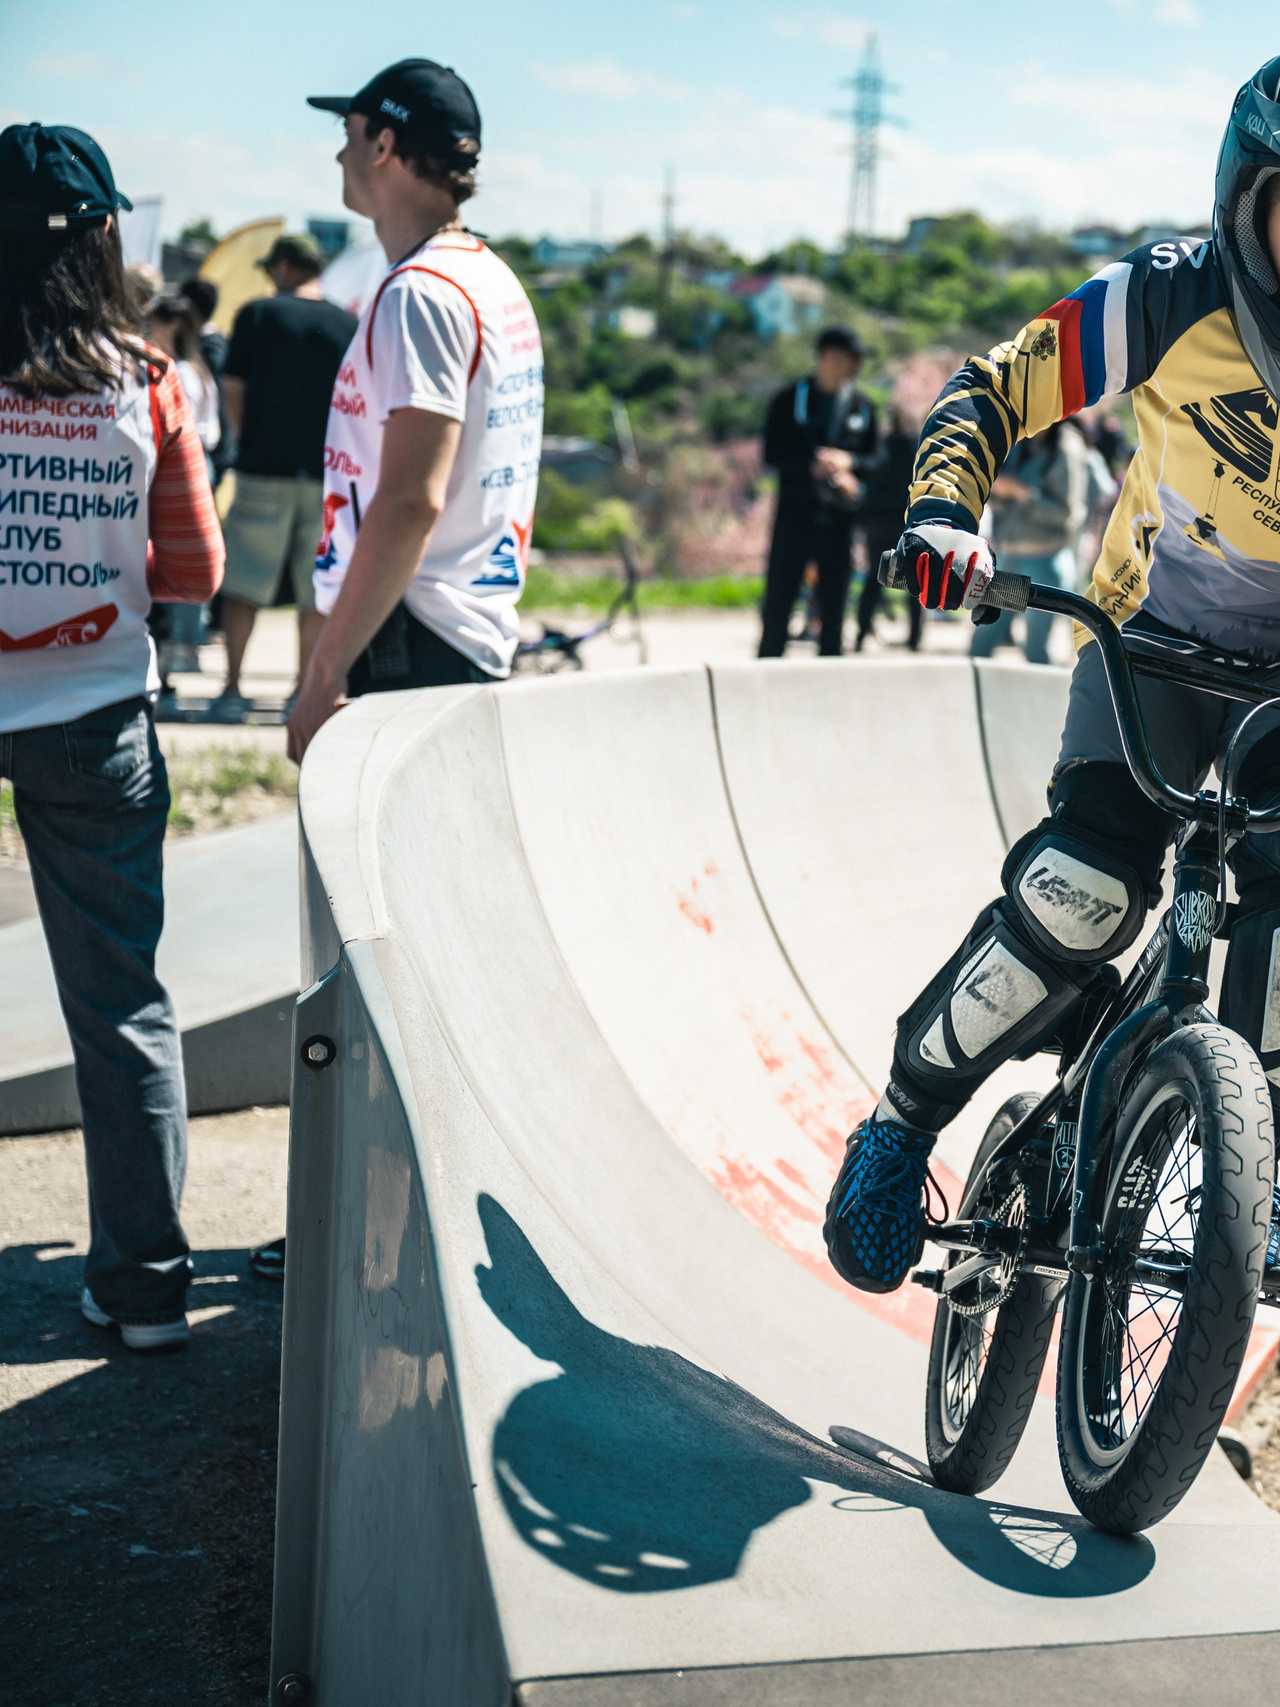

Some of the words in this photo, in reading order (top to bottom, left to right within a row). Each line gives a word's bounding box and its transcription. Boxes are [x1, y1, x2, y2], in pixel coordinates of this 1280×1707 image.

[380, 97, 411, 124] BMX
[0, 524, 62, 552] ЛУБ
[968, 563, 992, 599] FUZZ
